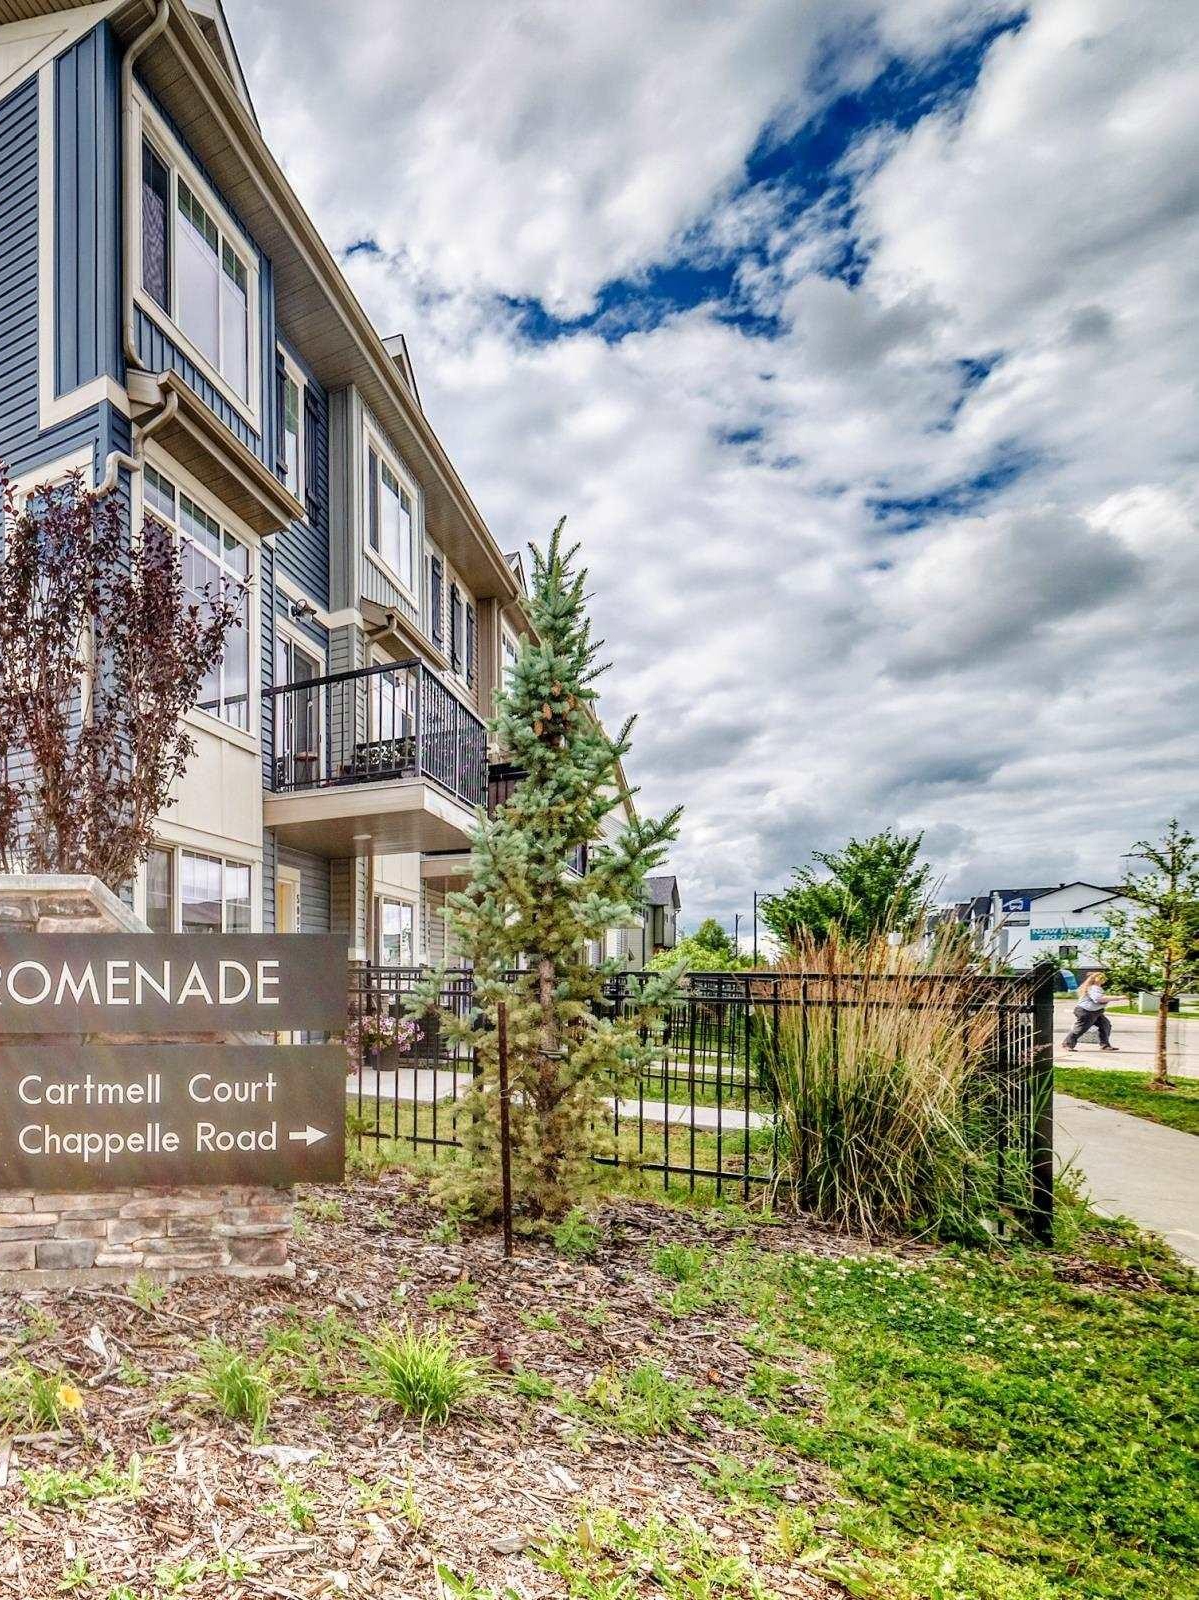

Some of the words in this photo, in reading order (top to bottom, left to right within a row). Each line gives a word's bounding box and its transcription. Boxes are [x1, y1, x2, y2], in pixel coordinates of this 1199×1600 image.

[18, 1074, 161, 1105] Cartmell
[188, 1073, 277, 1103] Court
[18, 1123, 180, 1163] Chappelle
[196, 1121, 277, 1152] Road
